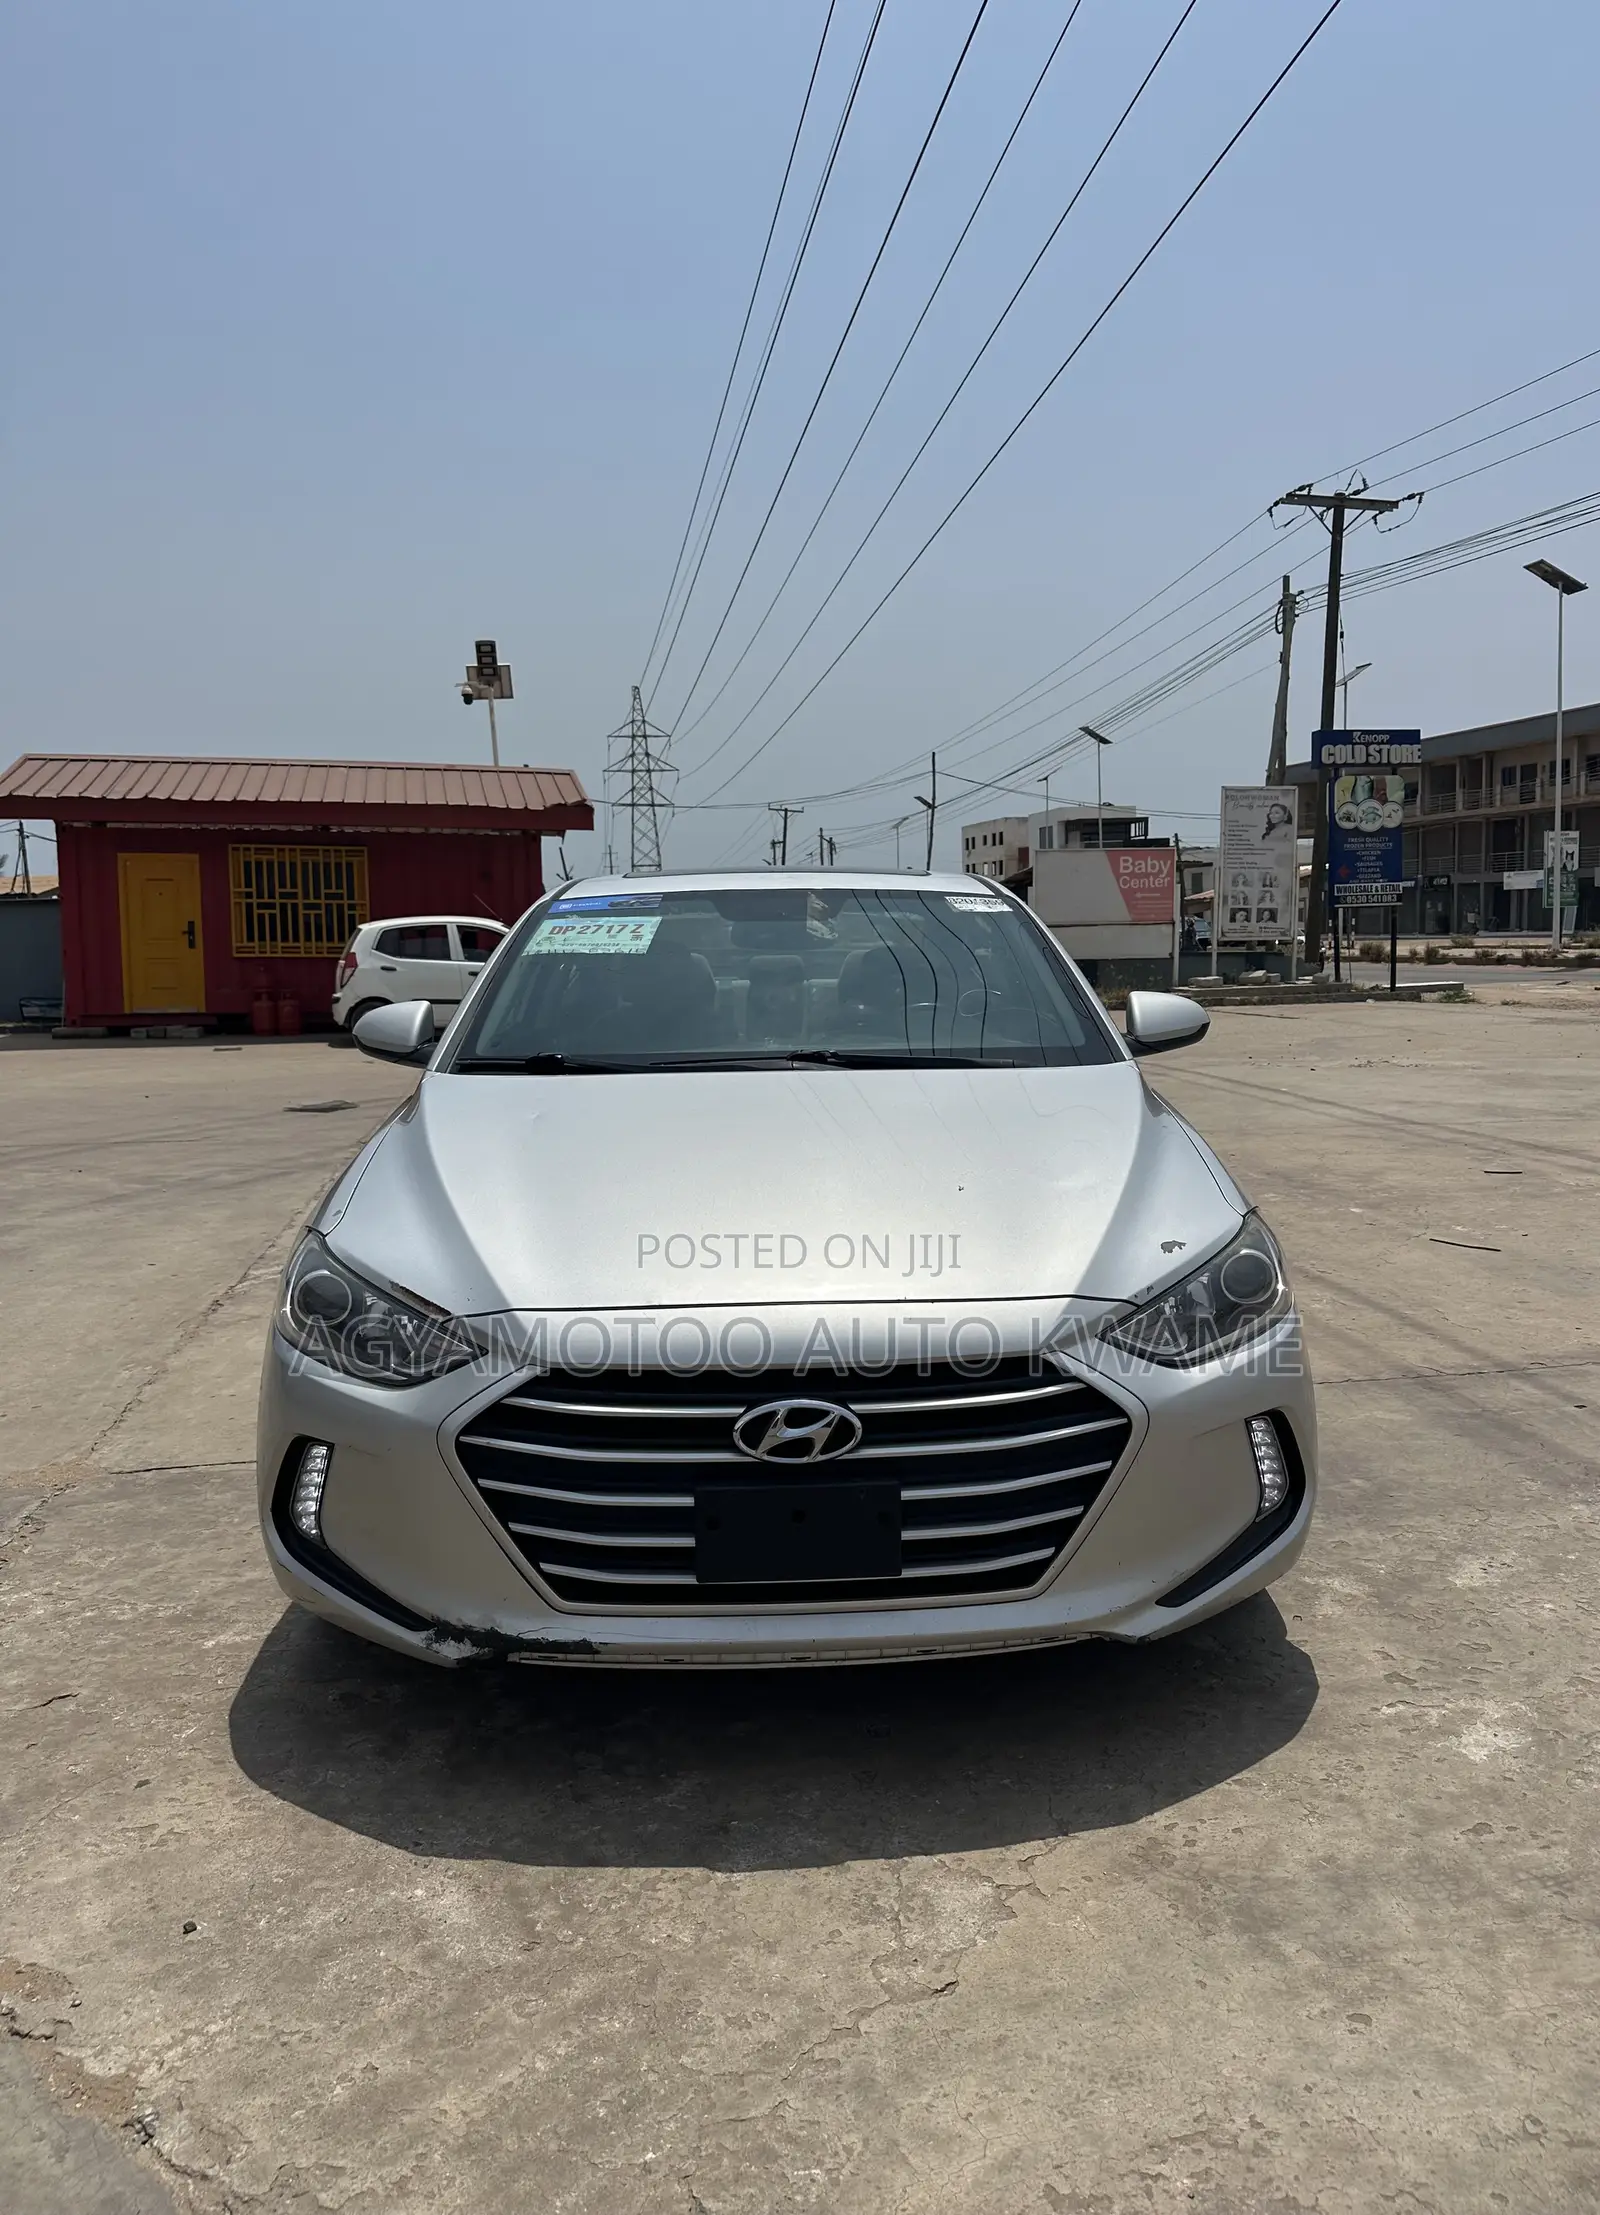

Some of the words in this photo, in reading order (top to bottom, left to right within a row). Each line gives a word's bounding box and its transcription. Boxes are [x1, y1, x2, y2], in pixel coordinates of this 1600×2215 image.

[1352, 732, 1390, 743] KENOPP
[1321, 744, 1366, 764] COLD
[1368, 744, 1422, 764] STORE
[1120, 856, 1172, 877] Baby
[1120, 876, 1170, 888] Center
[1336, 884, 1373, 894] WHOLESALE
[1380, 884, 1402, 892] RETAIL
[548, 925, 576, 935] DP
[576, 924, 629, 935] 2717
[630, 924, 645, 934] Z
